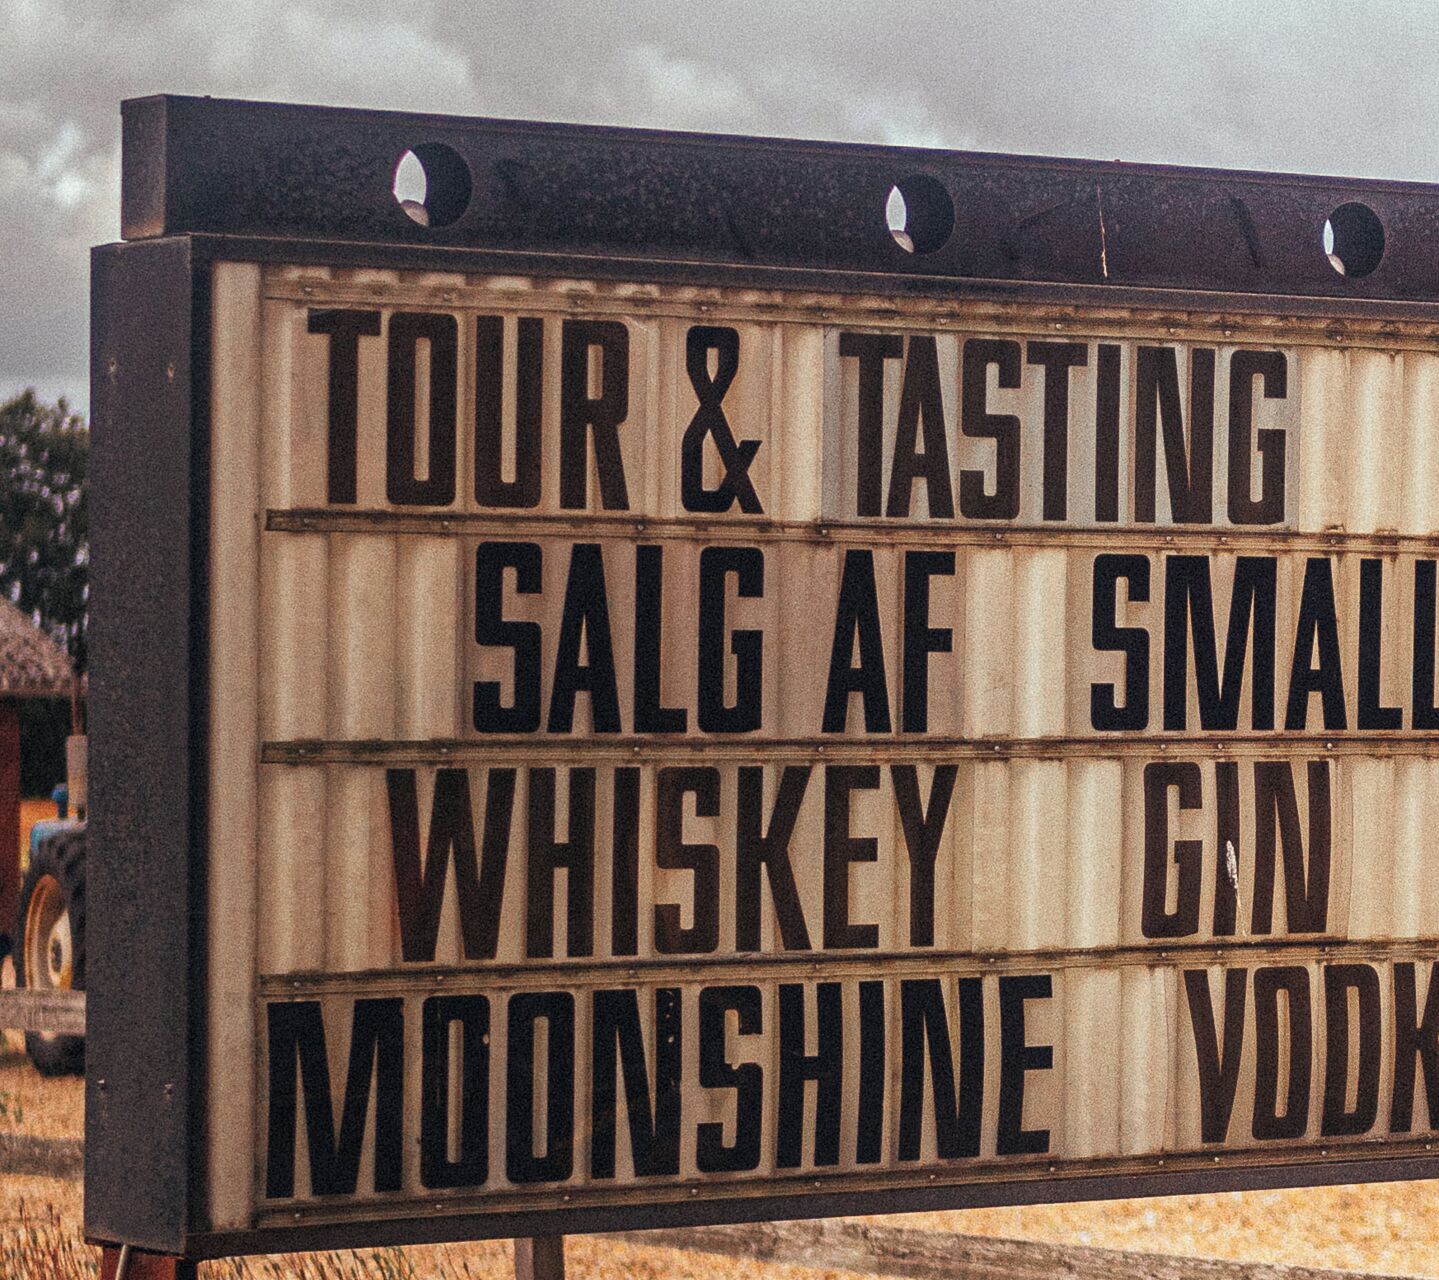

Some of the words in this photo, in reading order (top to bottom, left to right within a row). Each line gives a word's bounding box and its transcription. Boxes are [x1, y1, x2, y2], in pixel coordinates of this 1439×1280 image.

[307, 308, 629, 511] TOUR
[681, 325, 763, 515] &
[839, 330, 1287, 522] TASTING
[472, 540, 765, 734] SALG
[821, 549, 957, 734] AF
[385, 763, 959, 962] WHISKEY
[1141, 760, 1332, 939] GIN
[265, 974, 1055, 1199] MOONSHINE
